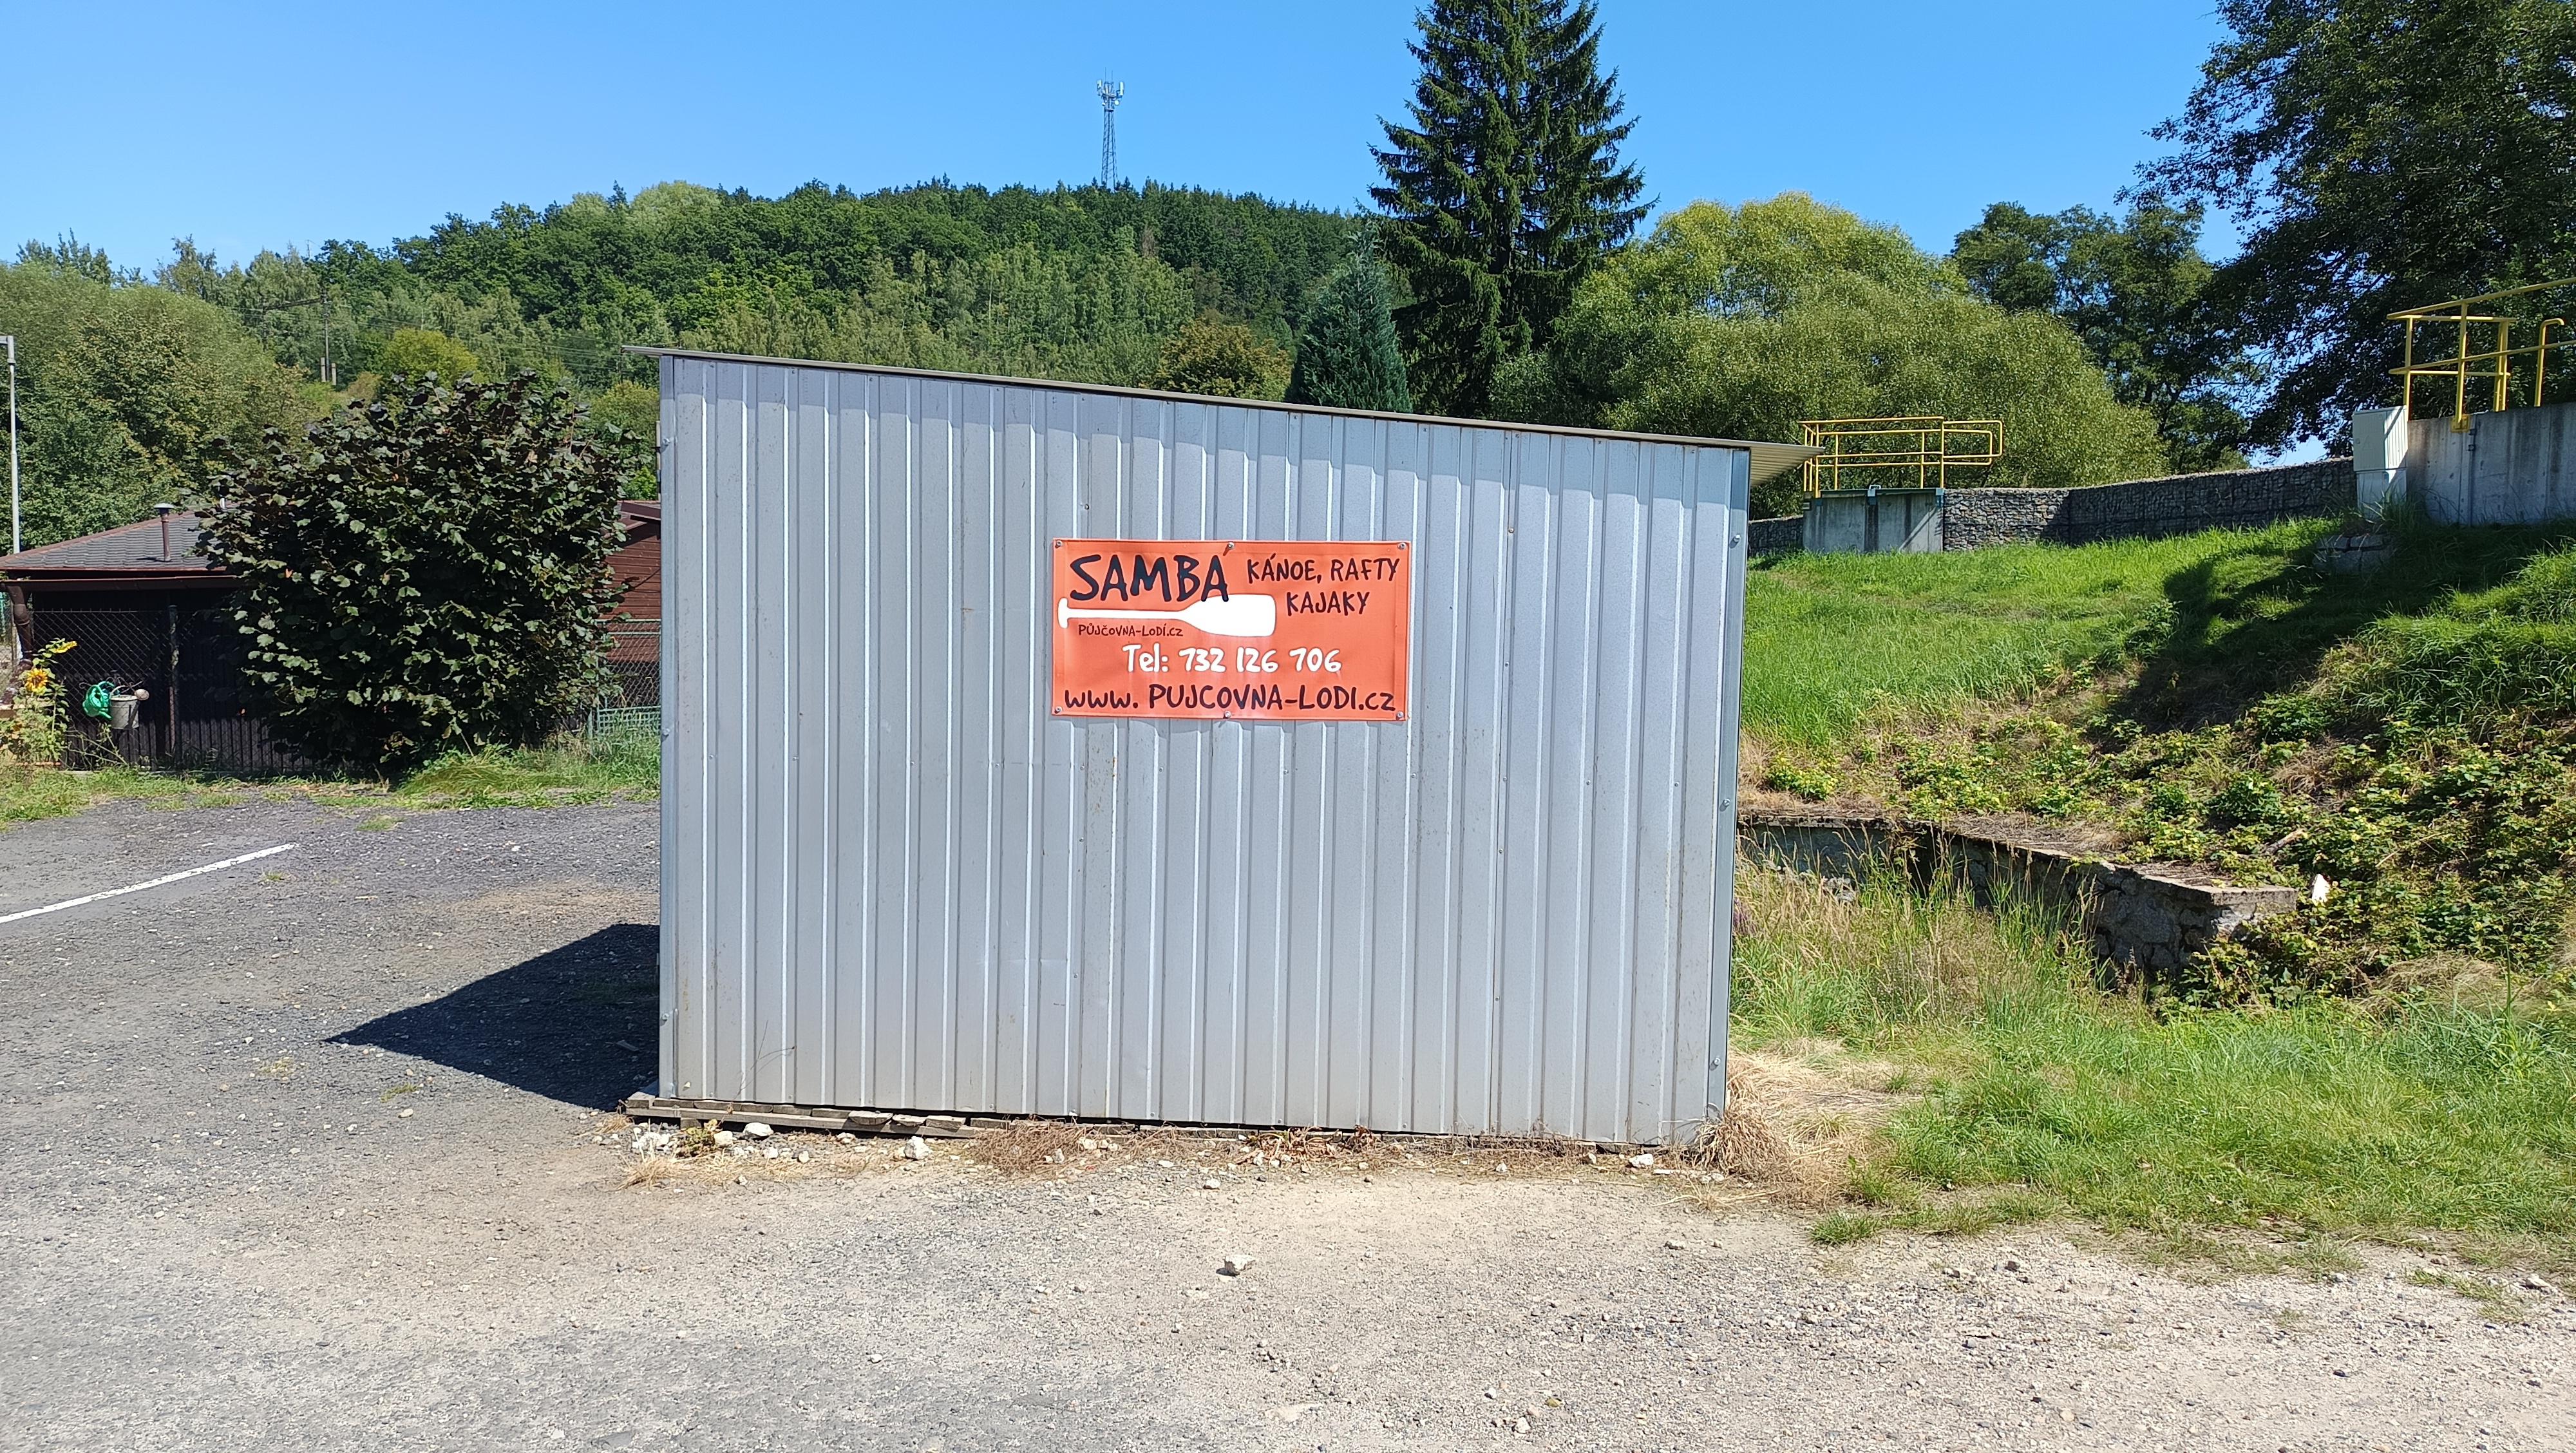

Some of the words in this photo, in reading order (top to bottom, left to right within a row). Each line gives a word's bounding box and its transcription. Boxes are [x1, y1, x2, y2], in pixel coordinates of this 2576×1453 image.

[1070, 554, 1229, 603] SAMBA
[1247, 553, 1322, 584] KÁNOE,
[1331, 558, 1400, 582] RAFTY
[1286, 591, 1370, 616] KAJAKY
[1122, 643, 1169, 673] Tel:
[1179, 647, 1226, 672] 732
[1236, 646, 1279, 673] 126
[1289, 647, 1342, 673] 706
